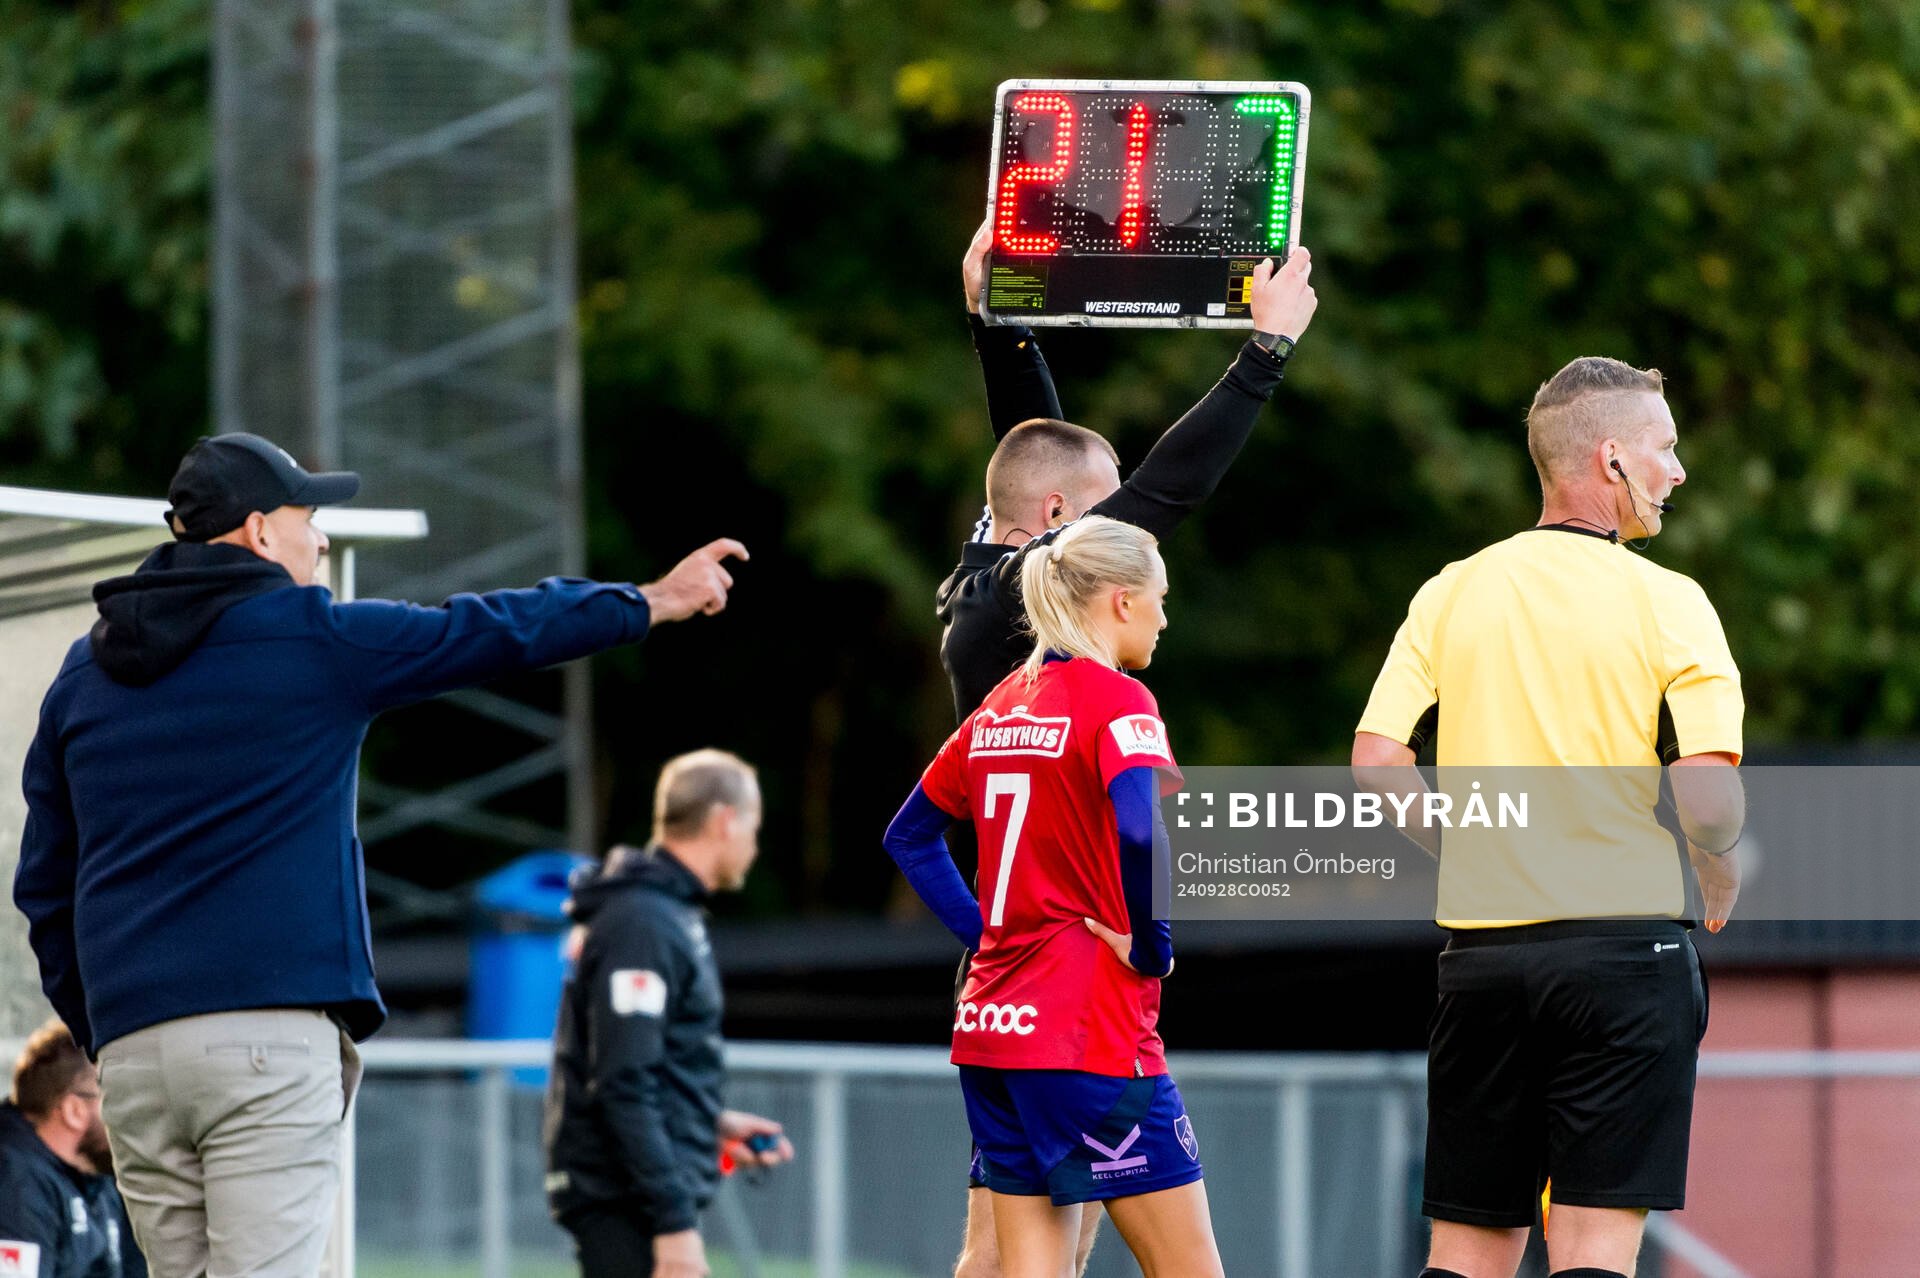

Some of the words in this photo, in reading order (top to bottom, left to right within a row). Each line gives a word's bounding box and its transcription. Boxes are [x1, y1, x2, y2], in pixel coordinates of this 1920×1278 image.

[1233, 96, 1294, 250] 7
[1085, 301, 1181, 314] WESTERSTRAND
[984, 773, 1031, 927] 7
[1092, 1172, 1113, 1180] KEEL
[1114, 1166, 1150, 1178] CAPITAL
